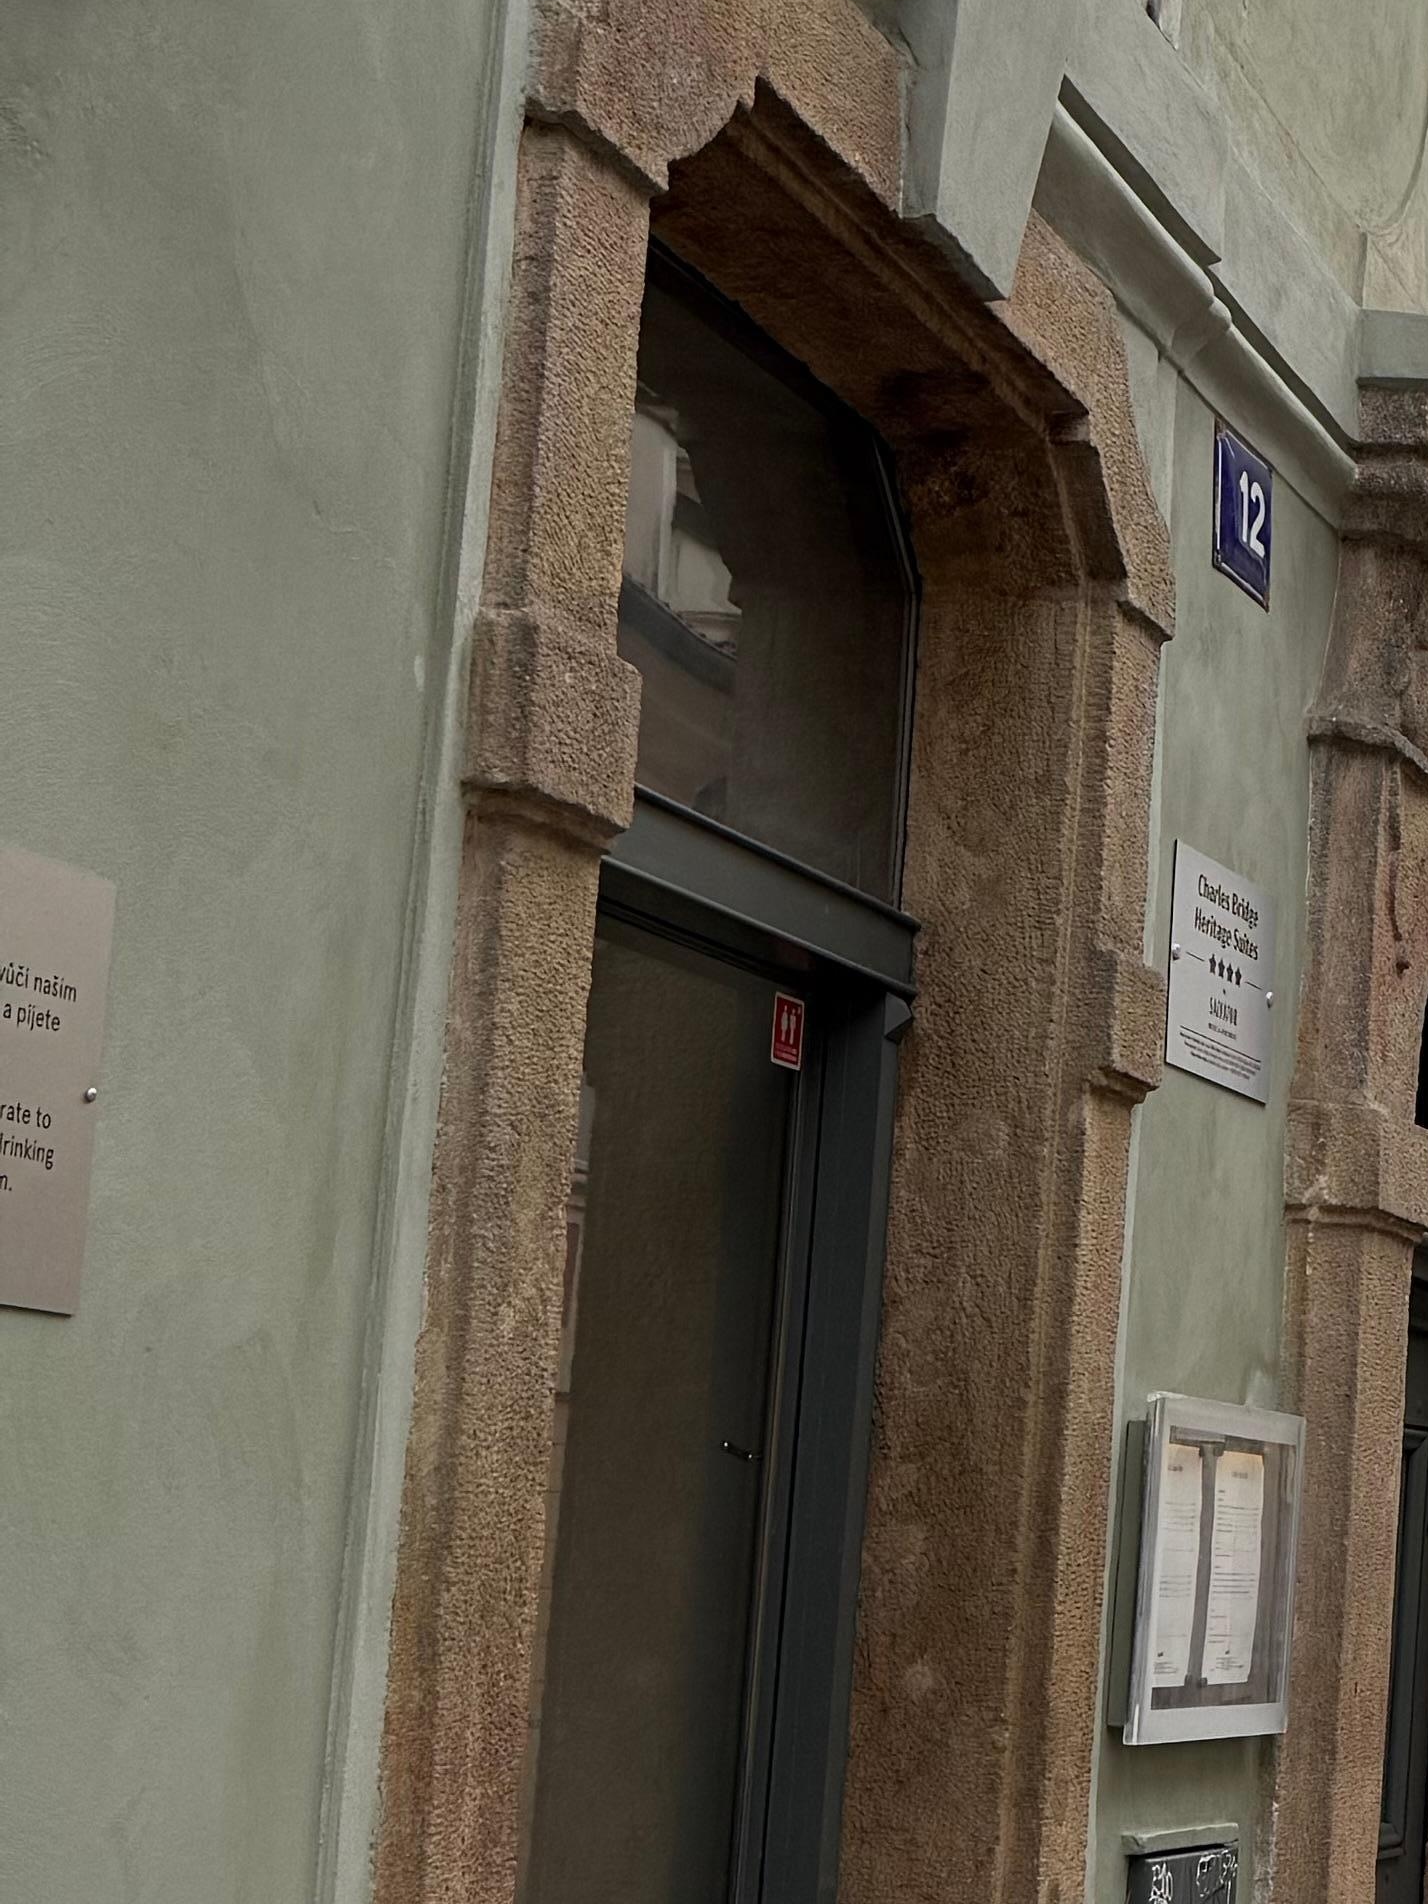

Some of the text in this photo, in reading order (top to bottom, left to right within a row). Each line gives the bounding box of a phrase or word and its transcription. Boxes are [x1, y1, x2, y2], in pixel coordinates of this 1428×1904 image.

[1239, 470, 1266, 559] 12
[1197, 873, 1259, 930] Charles Bridge
[1194, 906, 1259, 961] Heritage Suites
[2, 1003, 12, 1019] a
[36, 1106, 52, 1130] to
